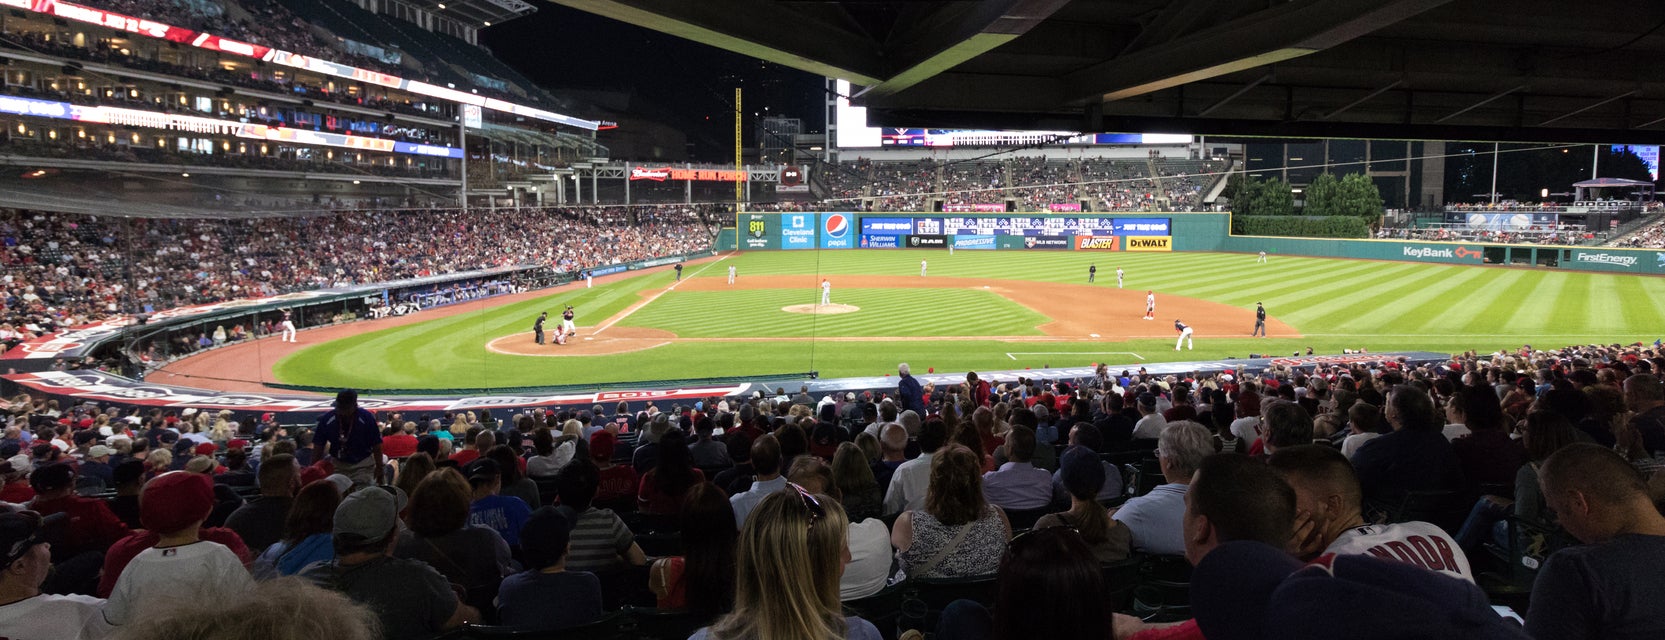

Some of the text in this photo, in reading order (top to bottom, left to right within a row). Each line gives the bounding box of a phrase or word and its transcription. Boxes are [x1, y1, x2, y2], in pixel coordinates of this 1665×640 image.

[632, 169, 668, 178] Budweiser
[671, 170, 747, 181] HOME RUN PORH
[749, 221, 764, 232] 811
[954, 237, 994, 246] PROGRESSIVE
[1080, 238, 1112, 249] BLASTER
[1403, 246, 1453, 258] KeyBank
